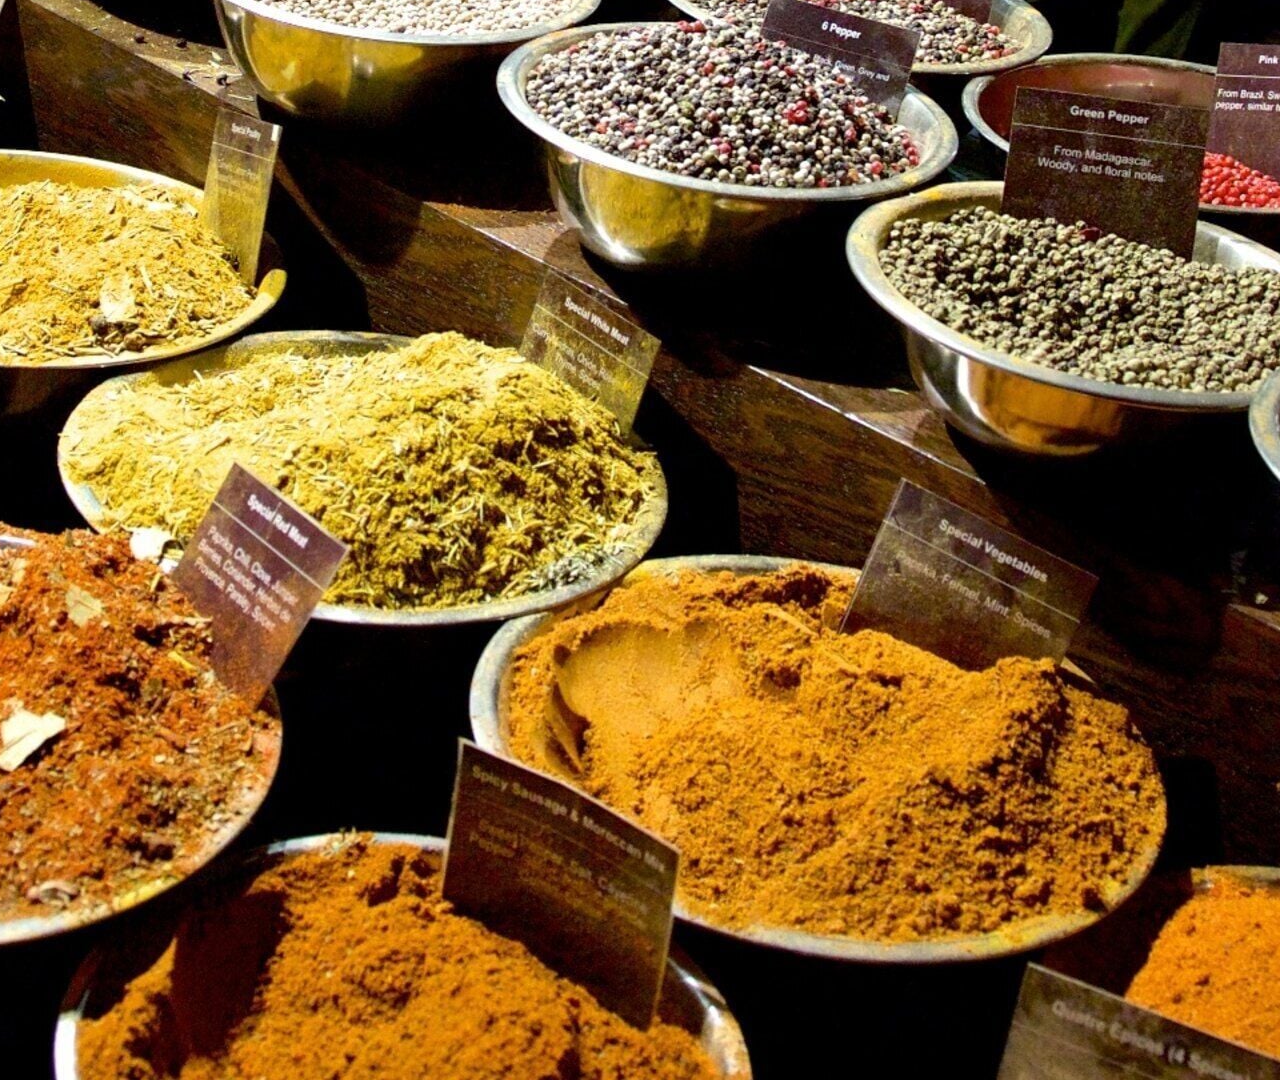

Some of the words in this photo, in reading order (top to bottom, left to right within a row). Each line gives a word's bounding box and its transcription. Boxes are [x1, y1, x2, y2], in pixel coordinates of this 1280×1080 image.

[821, 21, 829, 31] 6
[829, 22, 862, 40] Pepper
[1258, 55, 1278, 65] Pink
[876, 71, 890, 82] and
[1217, 88, 1239, 98] From
[1247, 102, 1274, 112] similar
[1070, 105, 1105, 120] Green
[1107, 109, 1149, 126] Pepper
[1053, 145, 1083, 159] From
[1081, 164, 1102, 175] and
[1104, 164, 1132, 178] floral
[610, 326, 630, 346] Meat
[247, 494, 273, 521] Special
[272, 514, 290, 535] Red
[288, 525, 309, 549] Meat
[939, 518, 984, 548] Special
[984, 541, 1049, 583] Vegetables
